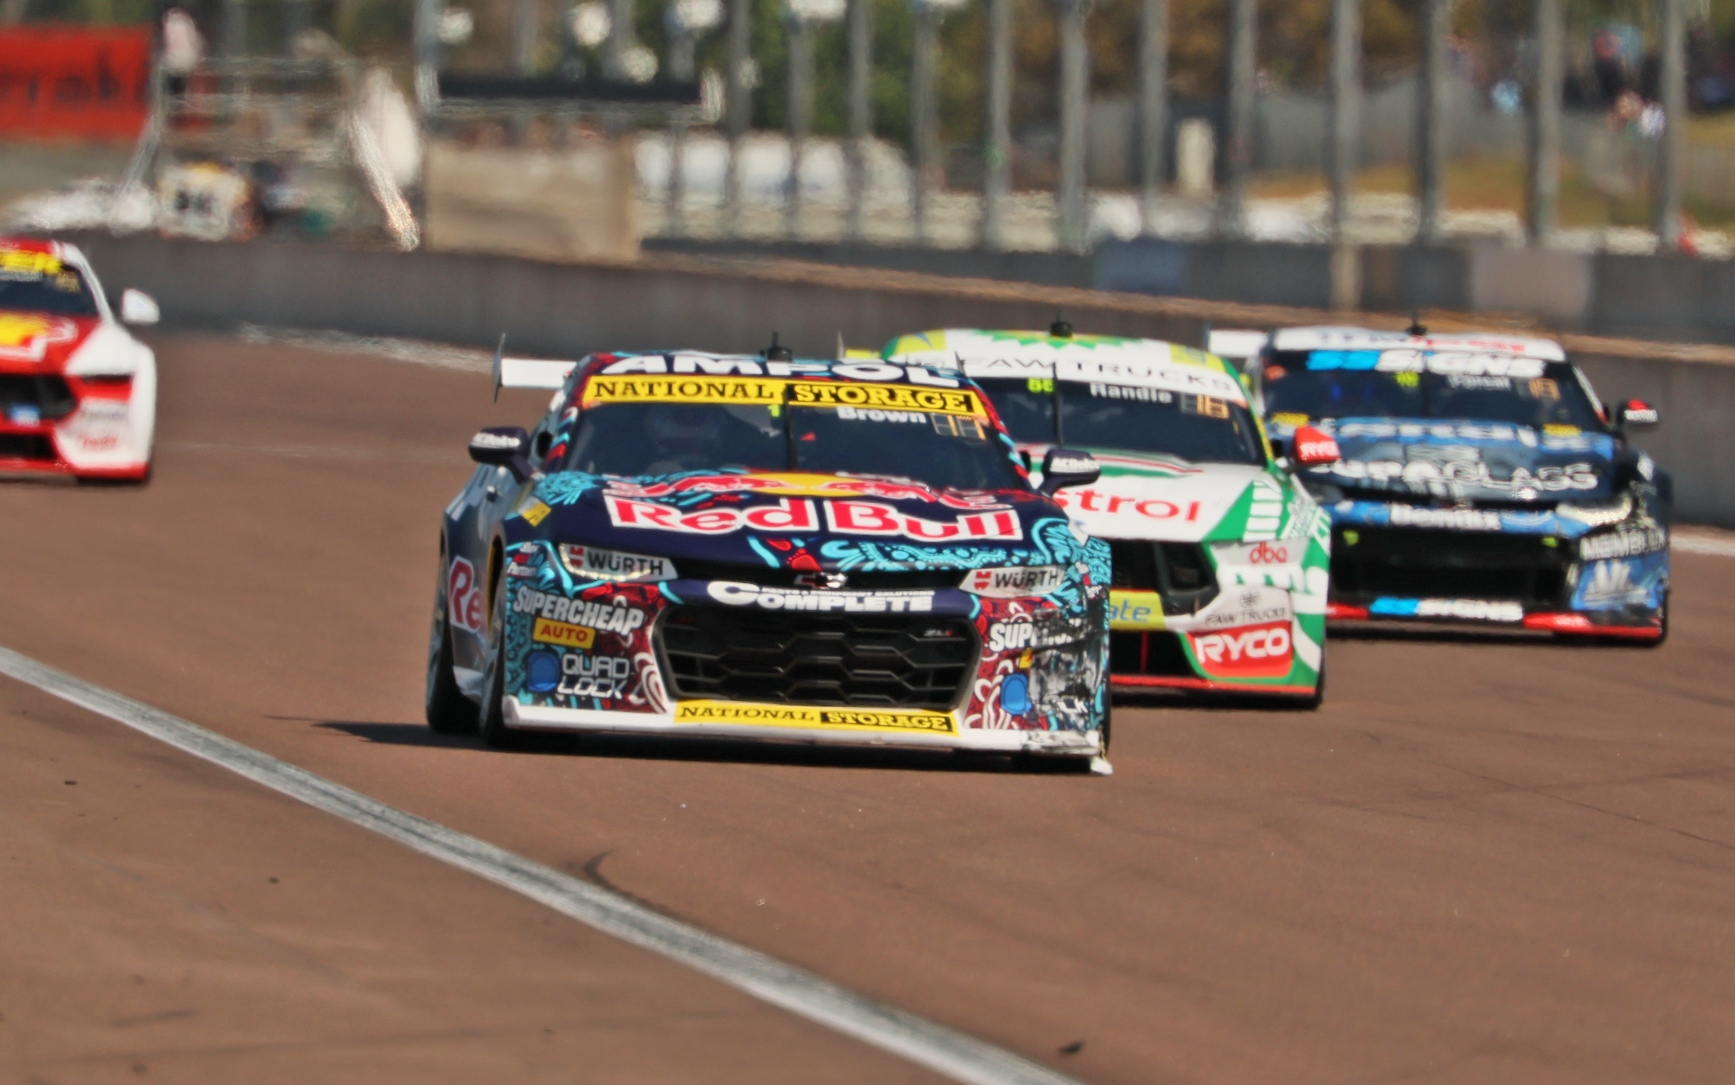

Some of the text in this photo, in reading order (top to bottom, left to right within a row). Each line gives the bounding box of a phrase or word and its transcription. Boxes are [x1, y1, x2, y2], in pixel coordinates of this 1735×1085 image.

[601, 355, 960, 387] AMPOL
[1075, 362, 1232, 392] TRUCKS
[593, 380, 967, 412] NATIONAL STORAGE
[836, 406, 927, 424] Brown
[603, 494, 1024, 541] Red Bull
[1052, 487, 1201, 522] strol
[588, 550, 664, 576] WÜRTH
[1249, 541, 1288, 565] dba
[448, 555, 482, 633] Re
[707, 580, 933, 612] COMPLETE
[512, 585, 645, 636] SUPERCHEAP
[540, 624, 589, 643] AUTO
[1195, 627, 1290, 664] RYCO
[561, 653, 630, 678] QUAD
[557, 677, 623, 699] LOCK
[679, 706, 948, 730] NATIONAL STORAGE
